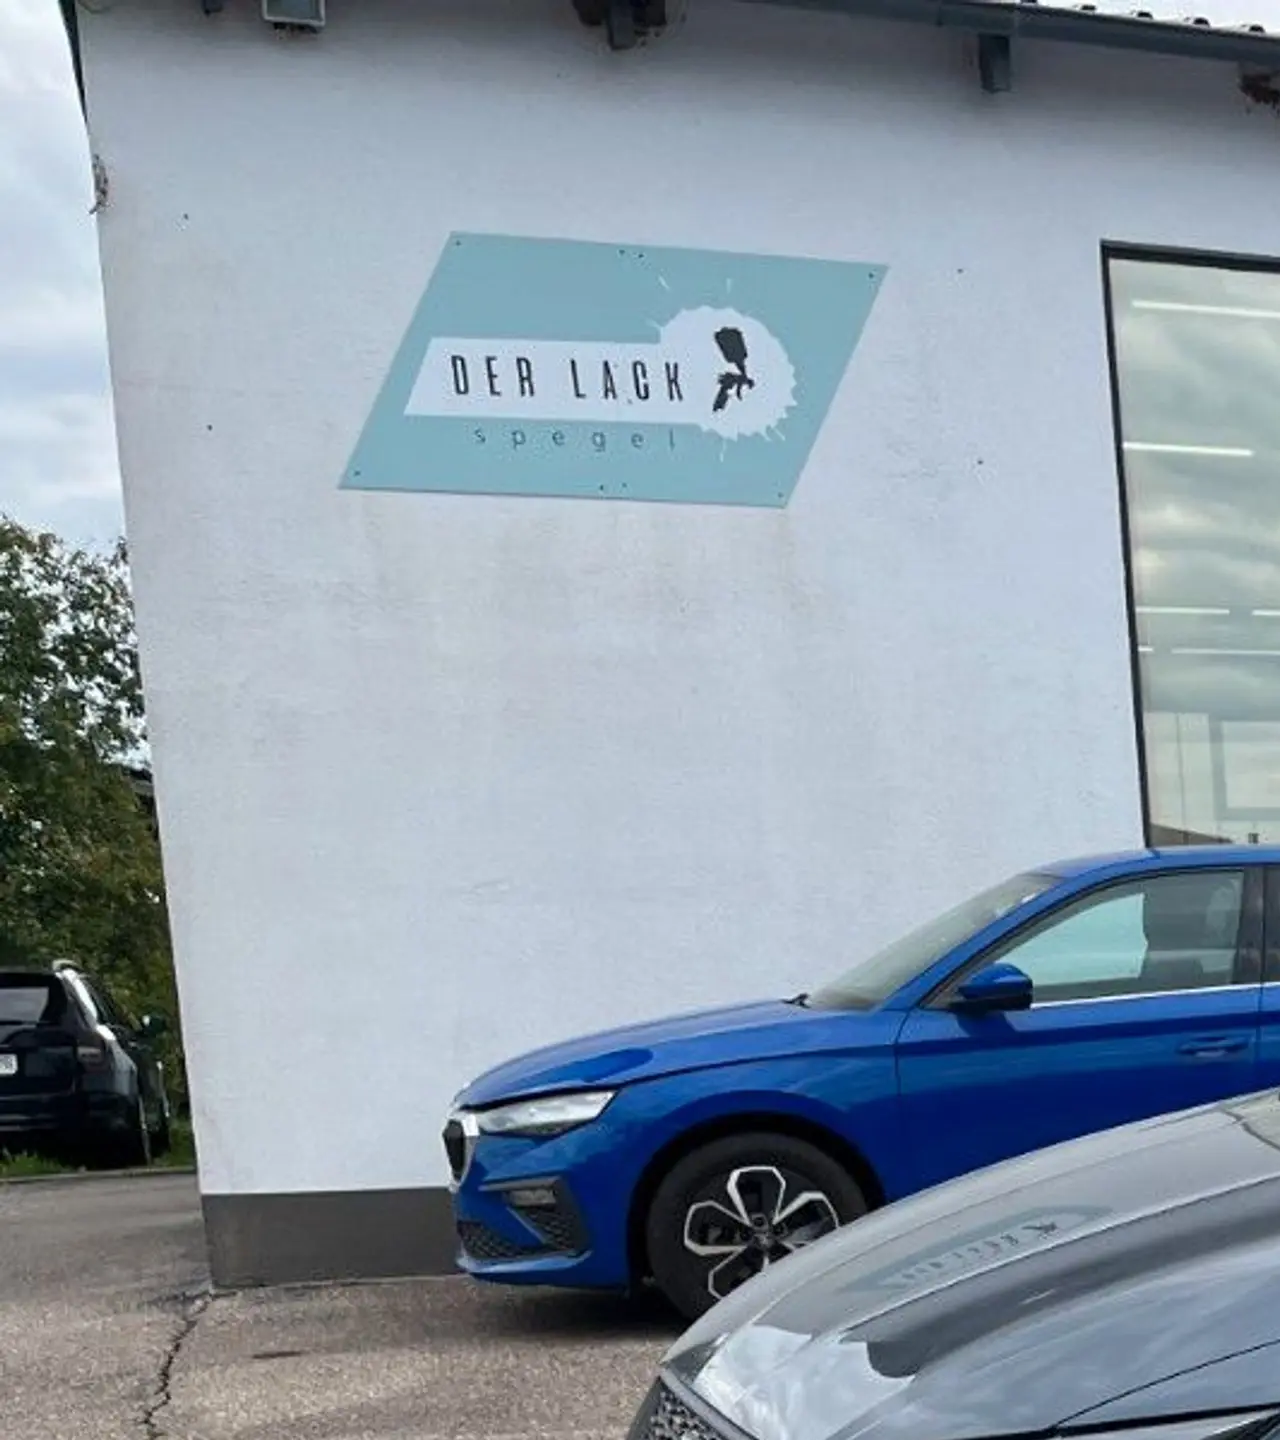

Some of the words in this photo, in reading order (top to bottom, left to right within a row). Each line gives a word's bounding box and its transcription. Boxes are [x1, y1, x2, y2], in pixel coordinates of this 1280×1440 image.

[451, 355, 535, 397] DER
[570, 358, 684, 402] LACK
[473, 427, 676, 452] spegel
